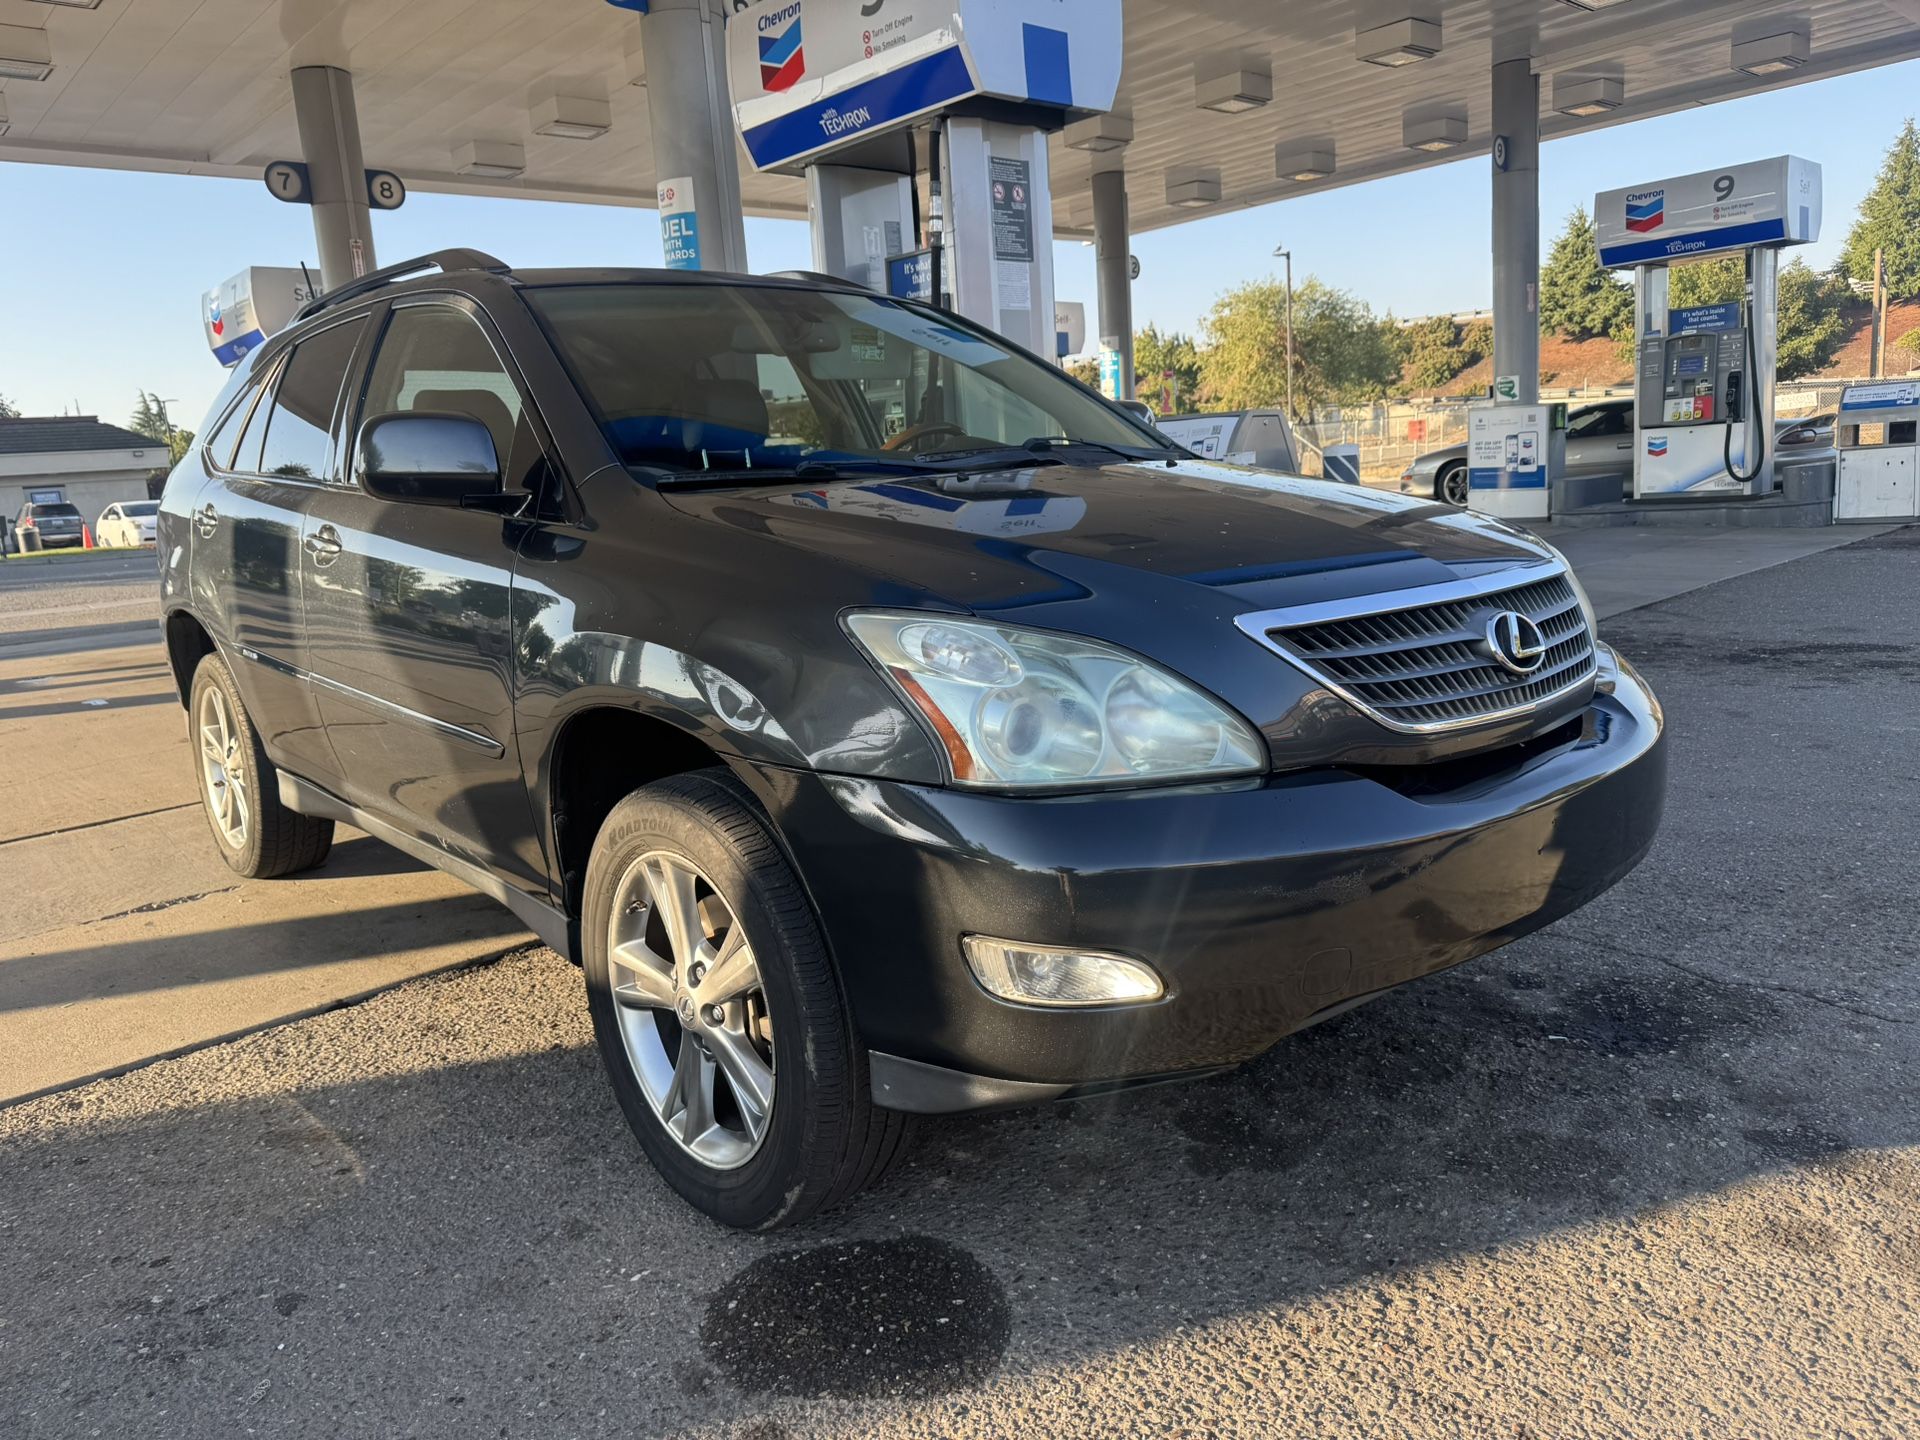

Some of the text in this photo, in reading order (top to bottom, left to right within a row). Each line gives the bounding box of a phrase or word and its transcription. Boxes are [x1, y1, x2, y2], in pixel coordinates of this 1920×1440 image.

[758, 1, 801, 32] Chevron
[872, 14, 913, 38] Turn Off Engine
[882, 34, 906, 50] Smoking
[819, 106, 871, 136] TECHRON
[821, 107, 838, 120] with
[276, 172, 290, 191] 7
[379, 181, 394, 199] 8
[1713, 175, 1735, 202] 9
[1626, 189, 1664, 202] Chevron
[661, 218, 693, 239] UEL
[1665, 241, 1706, 253] TECHRON
[904, 262, 915, 275] It's
[912, 271, 925, 285] that
[1691, 309, 1708, 317] what's
